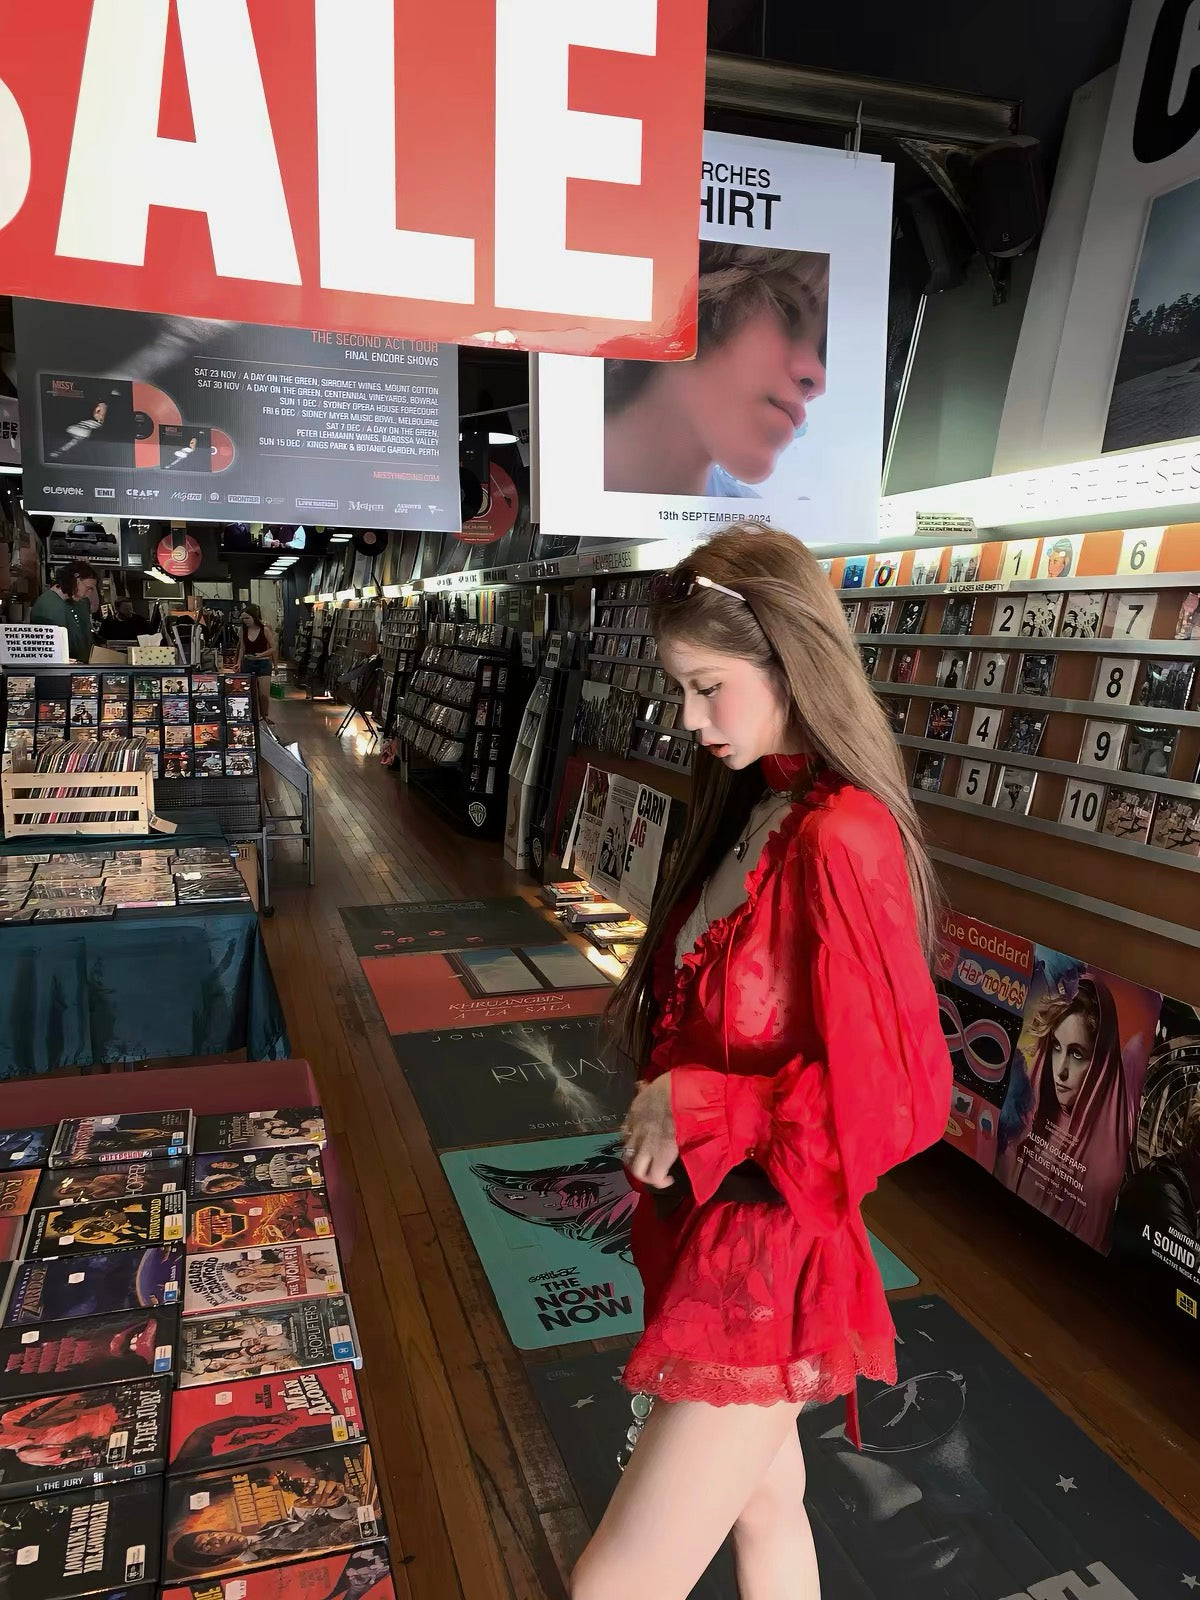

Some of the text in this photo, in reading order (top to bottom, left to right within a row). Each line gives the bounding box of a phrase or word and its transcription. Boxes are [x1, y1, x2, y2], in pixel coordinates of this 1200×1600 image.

[0, 0, 657, 322] ALE
[311, 331, 438, 353] THE SECOND ACT TOUR
[345, 351, 439, 366] FINAL ENCORE SHOWS
[194, 368, 208, 377] SAT
[210, 369, 219, 378] 23
[221, 370, 237, 379] NOV
[243, 372, 249, 380] A
[250, 373, 266, 381] DAY
[267, 374, 278, 382] ON
[279, 375, 293, 384] THE
[294, 376, 320, 387] GREEN,
[357, 381, 383, 391] WINES,
[384, 383, 410, 393] MOUNT
[412, 385, 439, 395] COTTON
[197, 380, 439, 406] SAT 30 NOV A DAY ON THE GREEN, CENTENNIAL VINEYARDS, BOWRAL
[263, 406, 274, 415] FRI
[275, 407, 280, 416] 6
[281, 408, 296, 417] DEC
[301, 409, 327, 419] SIDNEY
[328, 411, 349, 420] MYER
[350, 413, 373, 422] MUSIC
[398, 416, 439, 427] MELBOURNE
[280, 397, 439, 416] SUN DEC SYDNEY OPERA HOUSE FORECOURT
[297, 429, 318, 438] PETER
[319, 431, 354, 441] LEHMANN
[382, 435, 414, 444] BAROSSA
[415, 437, 439, 446] VALLEY
[326, 422, 339, 430] SAT
[347, 423, 360, 432] DEC
[366, 425, 372, 433] A
[374, 426, 388, 434] DAY
[389, 426, 399, 435] ON
[401, 427, 413, 436] THE
[259, 437, 274, 446] SUN
[277, 438, 285, 446] 15
[286, 439, 301, 447] DEC
[307, 442, 329, 450] KINGS
[330, 443, 348, 451] PARK
[349, 443, 355, 451] &
[356, 444, 387, 453] BOTANIC
[418, 448, 440, 457] PERTH
[97, 488, 113, 497] EMI
[126, 489, 160, 498] CRAFT
[229, 495, 260, 504] FRONTIER
[658, 511, 679, 521] 13th
[682, 511, 746, 524] SEPTEMBER
[1013, 549, 1023, 576] 1
[1130, 540, 1148, 571] 6
[999, 605, 1016, 632] 2
[1126, 604, 1144, 635] 7
[983, 660, 996, 687] 3
[1105, 667, 1124, 699] 8
[976, 716, 991, 743] 4
[1093, 731, 1111, 762] 9
[966, 768, 981, 796] 5
[637, 788, 667, 827] CARN
[1069, 789, 1098, 823] 10
[630, 816, 648, 849] AG
[624, 844, 635, 873] E
[940, 918, 1031, 969] Joe Goddard
[958, 962, 1025, 1010] Harmonics
[448, 994, 564, 1011] KHRUANGBIN
[485, 1003, 572, 1017] LA SALA
[431, 1031, 484, 1043] JON
[564, 1113, 617, 1126] AUGUST
[99, 1150, 144, 1163] CREEPSHOW
[1026, 1130, 1050, 1151] ALISON
[1049, 1145, 1087, 1174] GOLDFRAPP
[1023, 1145, 1035, 1160] THE
[1035, 1153, 1051, 1170] LOVE
[1050, 1164, 1084, 1193] INVENTION
[149, 1198, 162, 1240] FUTUREWORLD
[1142, 1223, 1151, 1241] A
[1153, 1230, 1195, 1269] SOUND
[1168, 1226, 1195, 1249] MONITOR
[188, 1259, 205, 1295] SHEARER
[202, 1257, 222, 1295] CRAWFORD
[283, 1246, 300, 1297] THE WOMEN
[540, 1277, 581, 1293] THE
[533, 1281, 616, 1312] NOW
[537, 1295, 633, 1332] NOW
[304, 1305, 325, 1360] SHOPLIFTERS
[283, 1378, 310, 1411] MAN
[300, 1373, 335, 1416] ALONE
[134, 1389, 161, 1444] THE JURY
[43, 1476, 84, 1492] THE JURY
[232, 1473, 259, 1526] TROUBLE
[251, 1481, 282, 1524] MAN
[62, 1503, 91, 1577] LOOKING FOR
